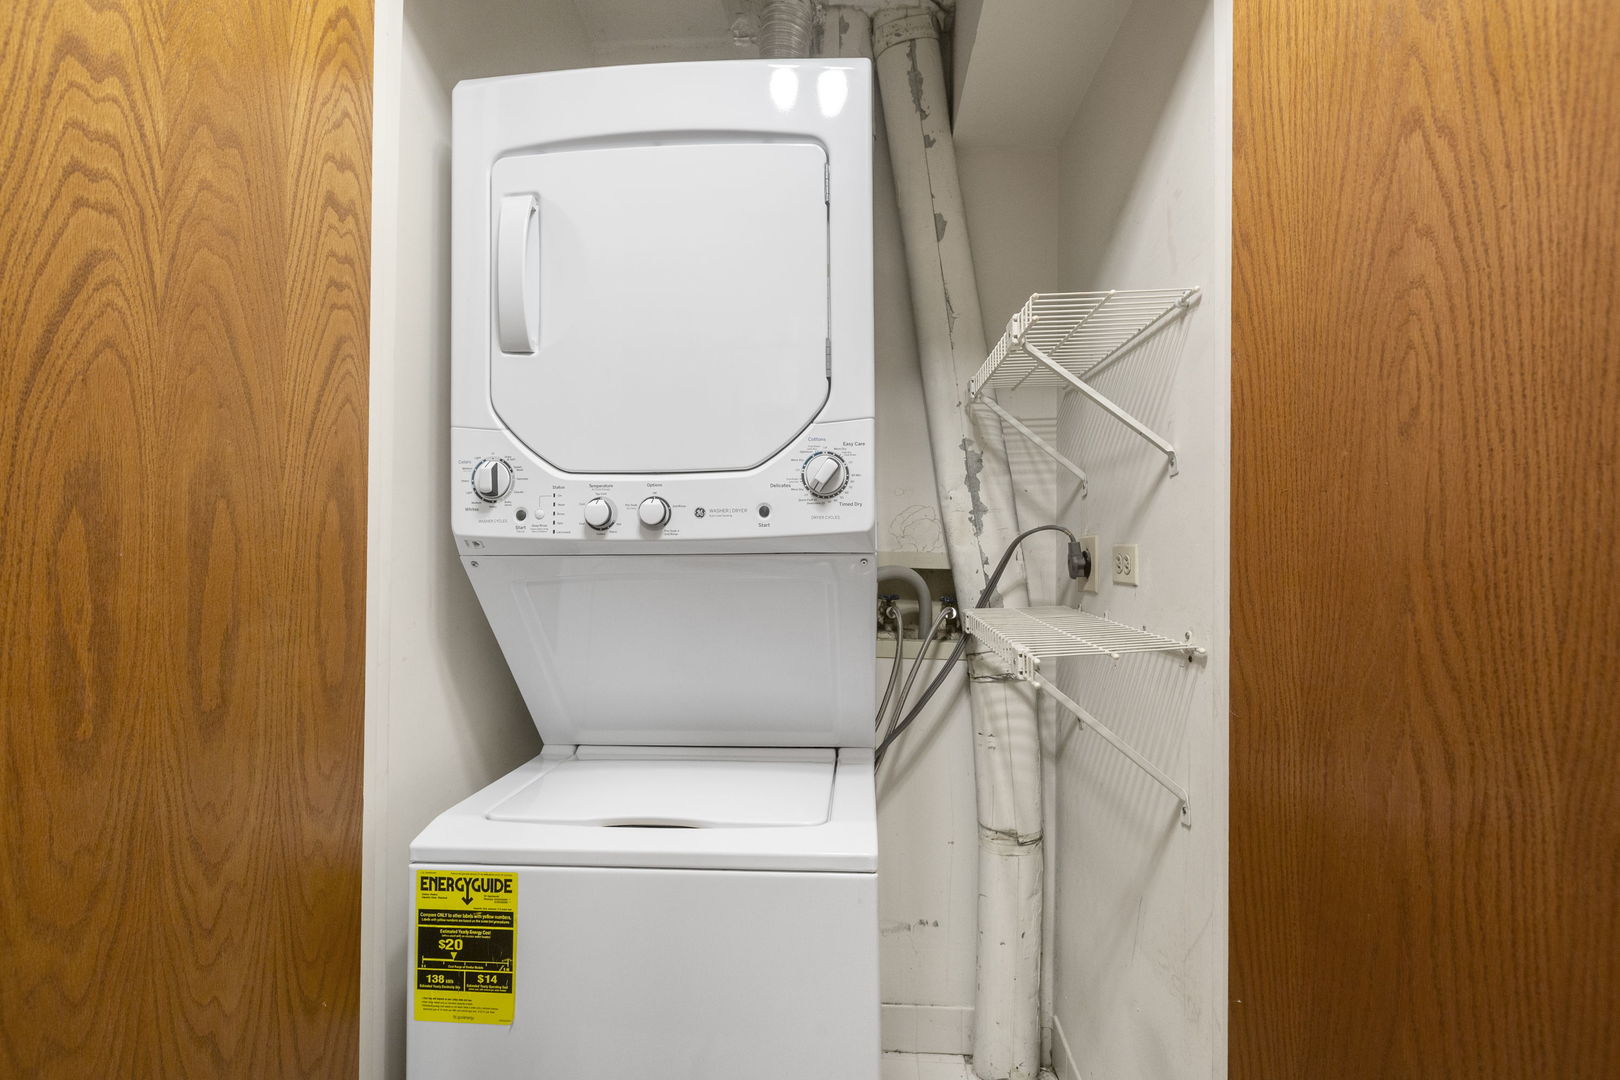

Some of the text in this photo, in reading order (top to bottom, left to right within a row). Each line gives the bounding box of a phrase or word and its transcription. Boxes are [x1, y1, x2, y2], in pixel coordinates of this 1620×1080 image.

[420, 876, 513, 893] ENERGYGUIDE
[438, 938, 463, 950] $20
[426, 974, 444, 984] 138
[477, 974, 497, 984] $14
